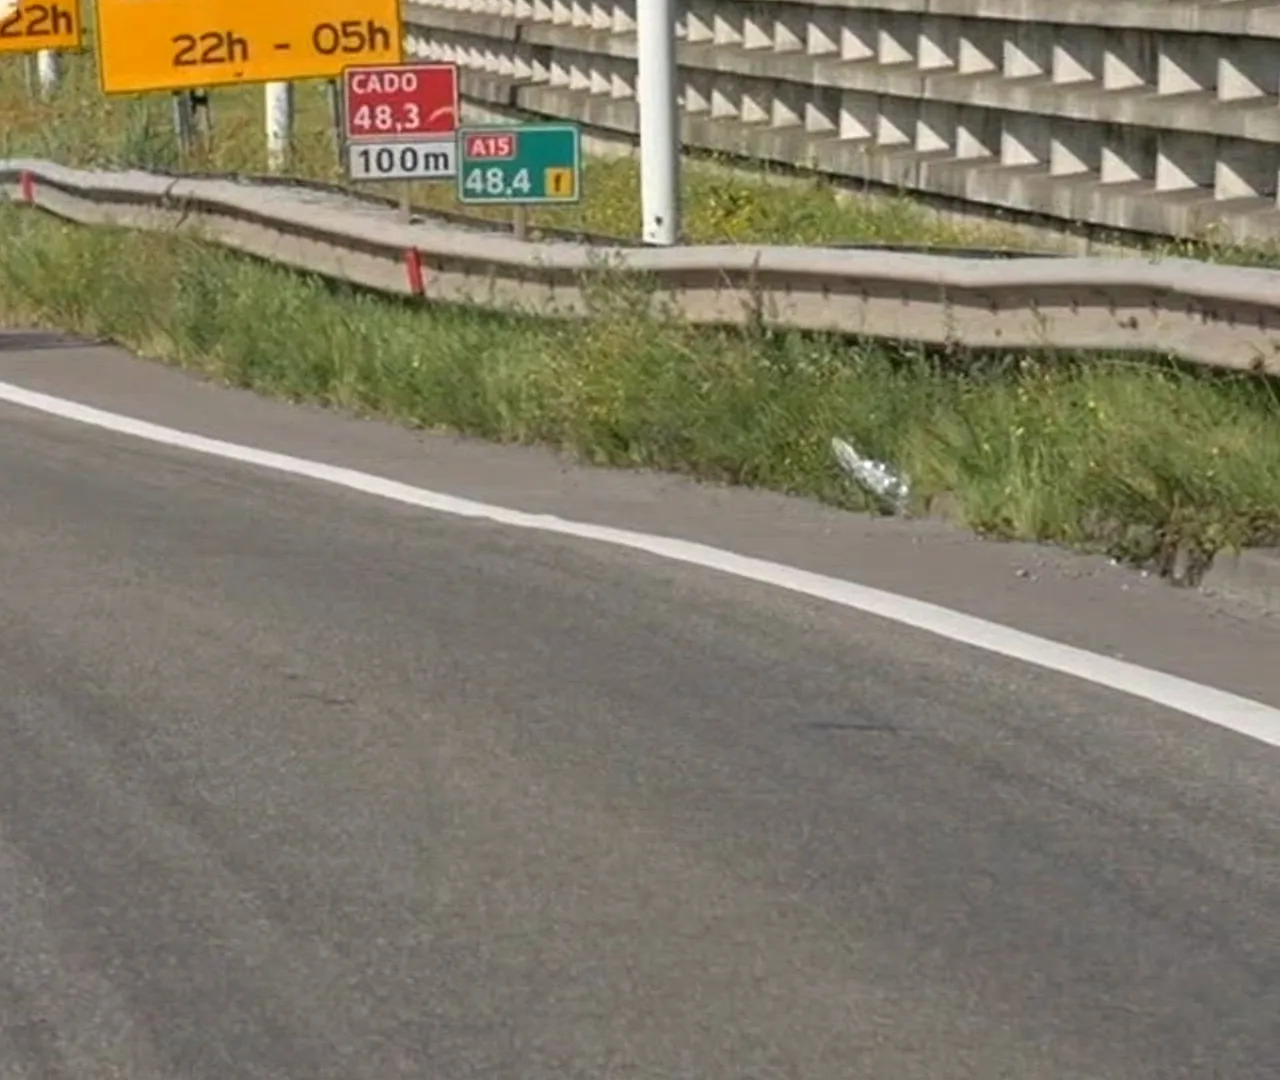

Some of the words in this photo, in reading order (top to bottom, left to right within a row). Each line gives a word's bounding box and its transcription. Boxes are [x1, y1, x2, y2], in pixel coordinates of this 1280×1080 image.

[172, 32, 248, 66] 22h
[313, 21, 390, 54] 05h
[352, 73, 417, 94] CADO
[353, 103, 421, 132] 48,3
[471, 139, 510, 156] A15
[359, 148, 449, 173] 100m
